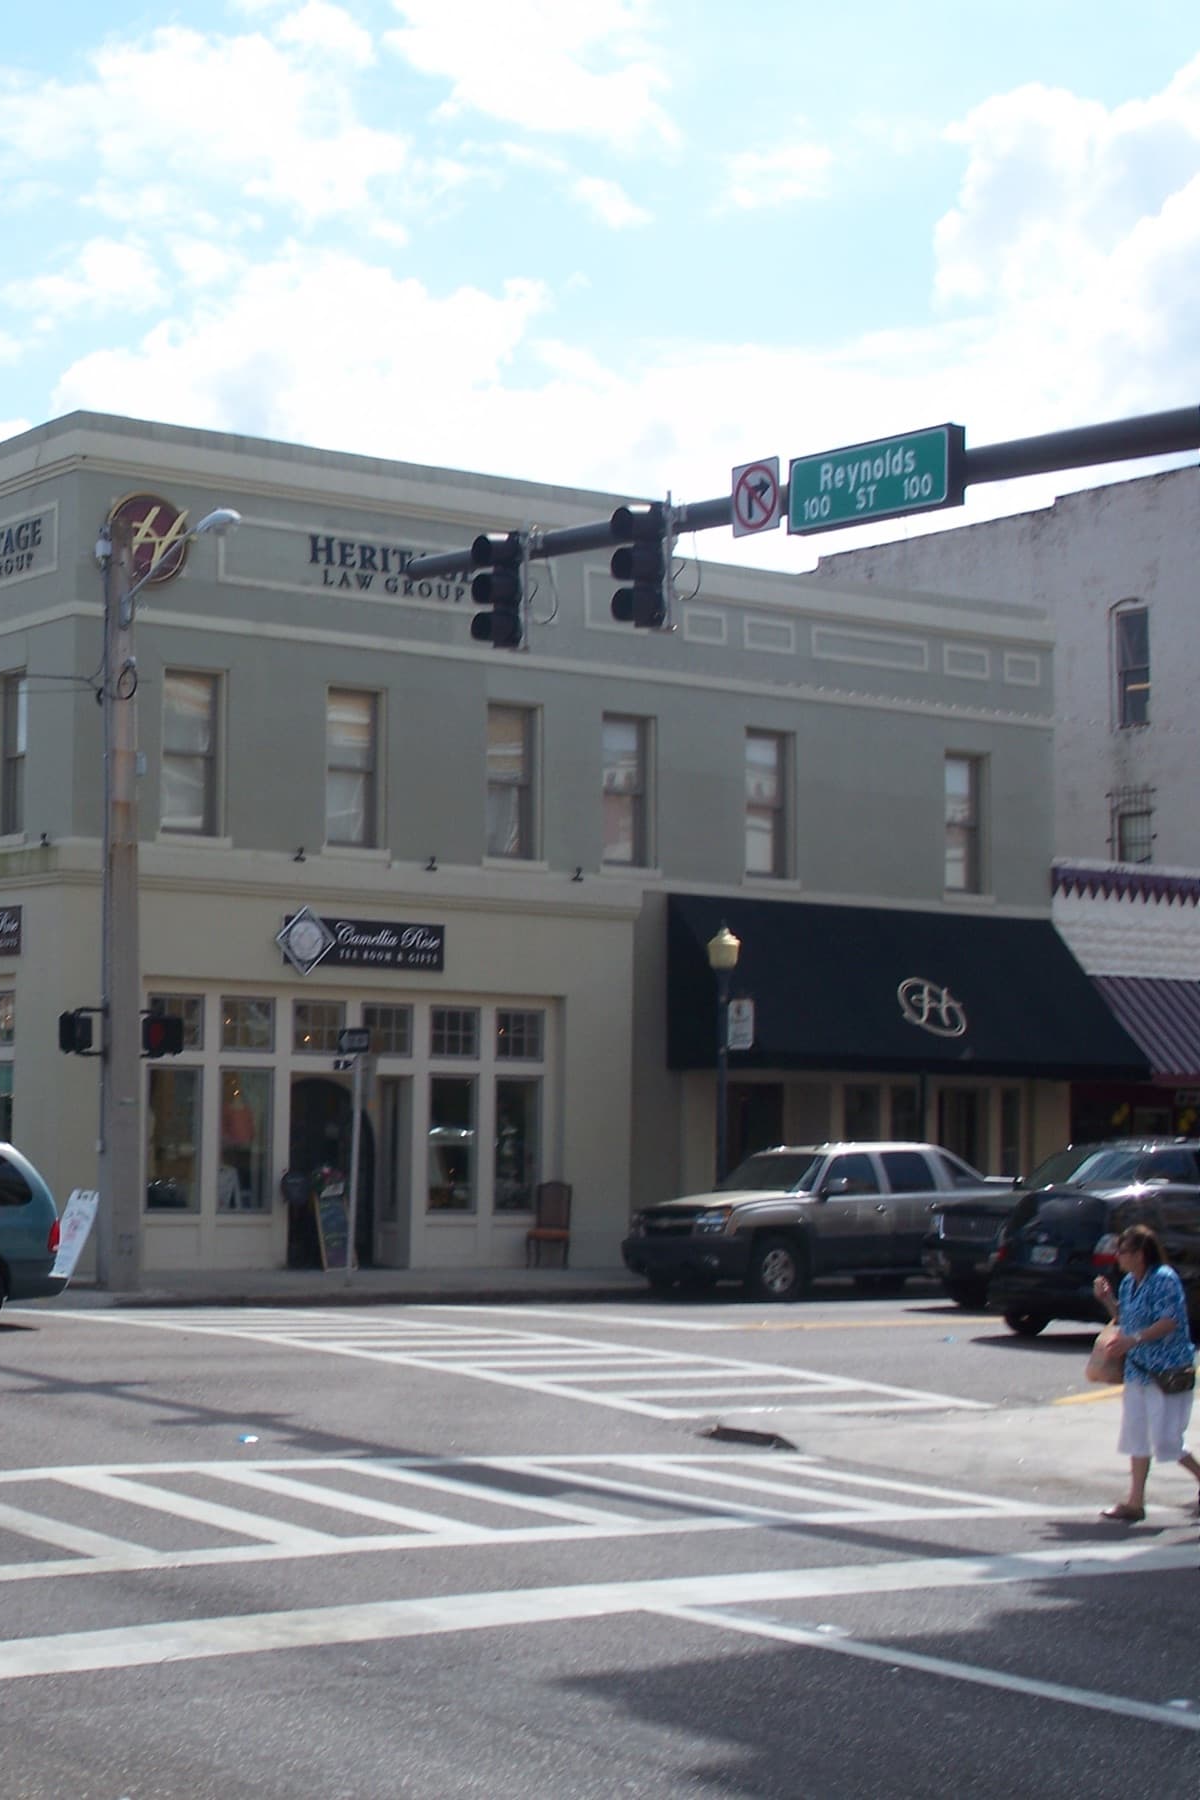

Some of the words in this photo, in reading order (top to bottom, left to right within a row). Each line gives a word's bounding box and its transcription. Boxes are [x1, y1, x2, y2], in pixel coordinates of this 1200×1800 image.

[820, 446, 916, 493] Reynolds
[803, 495, 831, 521] 100
[856, 485, 878, 511] ST
[903, 473, 933, 500] 100
[308, 534, 473, 582] HERIT
[323, 569, 374, 592] LAW
[385, 577, 466, 603] GROUP
[335, 921, 399, 946] Camellia
[400, 927, 441, 949] Rose
